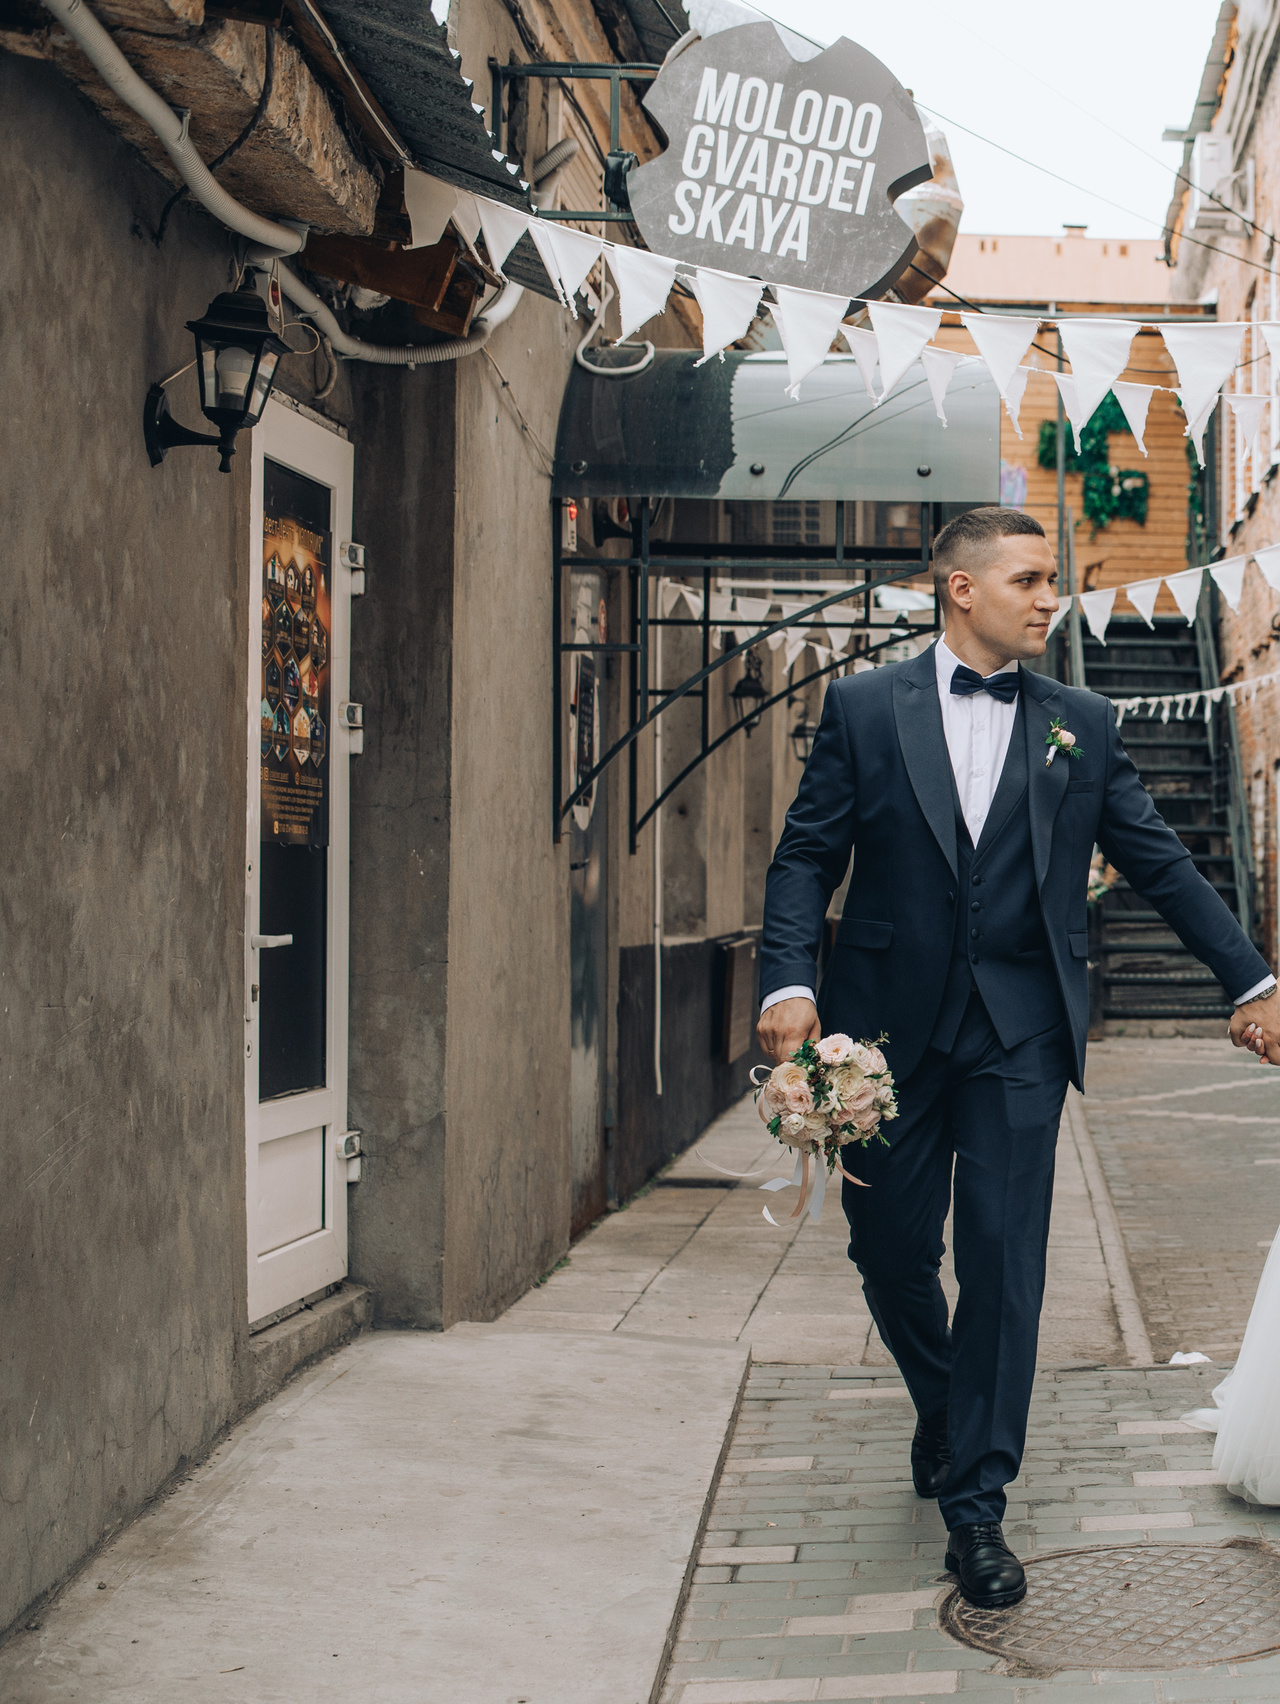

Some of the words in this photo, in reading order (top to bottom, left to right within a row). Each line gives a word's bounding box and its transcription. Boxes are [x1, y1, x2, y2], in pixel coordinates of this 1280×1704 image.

[694, 66, 883, 157] MOLODO
[682, 124, 876, 216] GVARDEI
[668, 180, 810, 262] SKAYA
